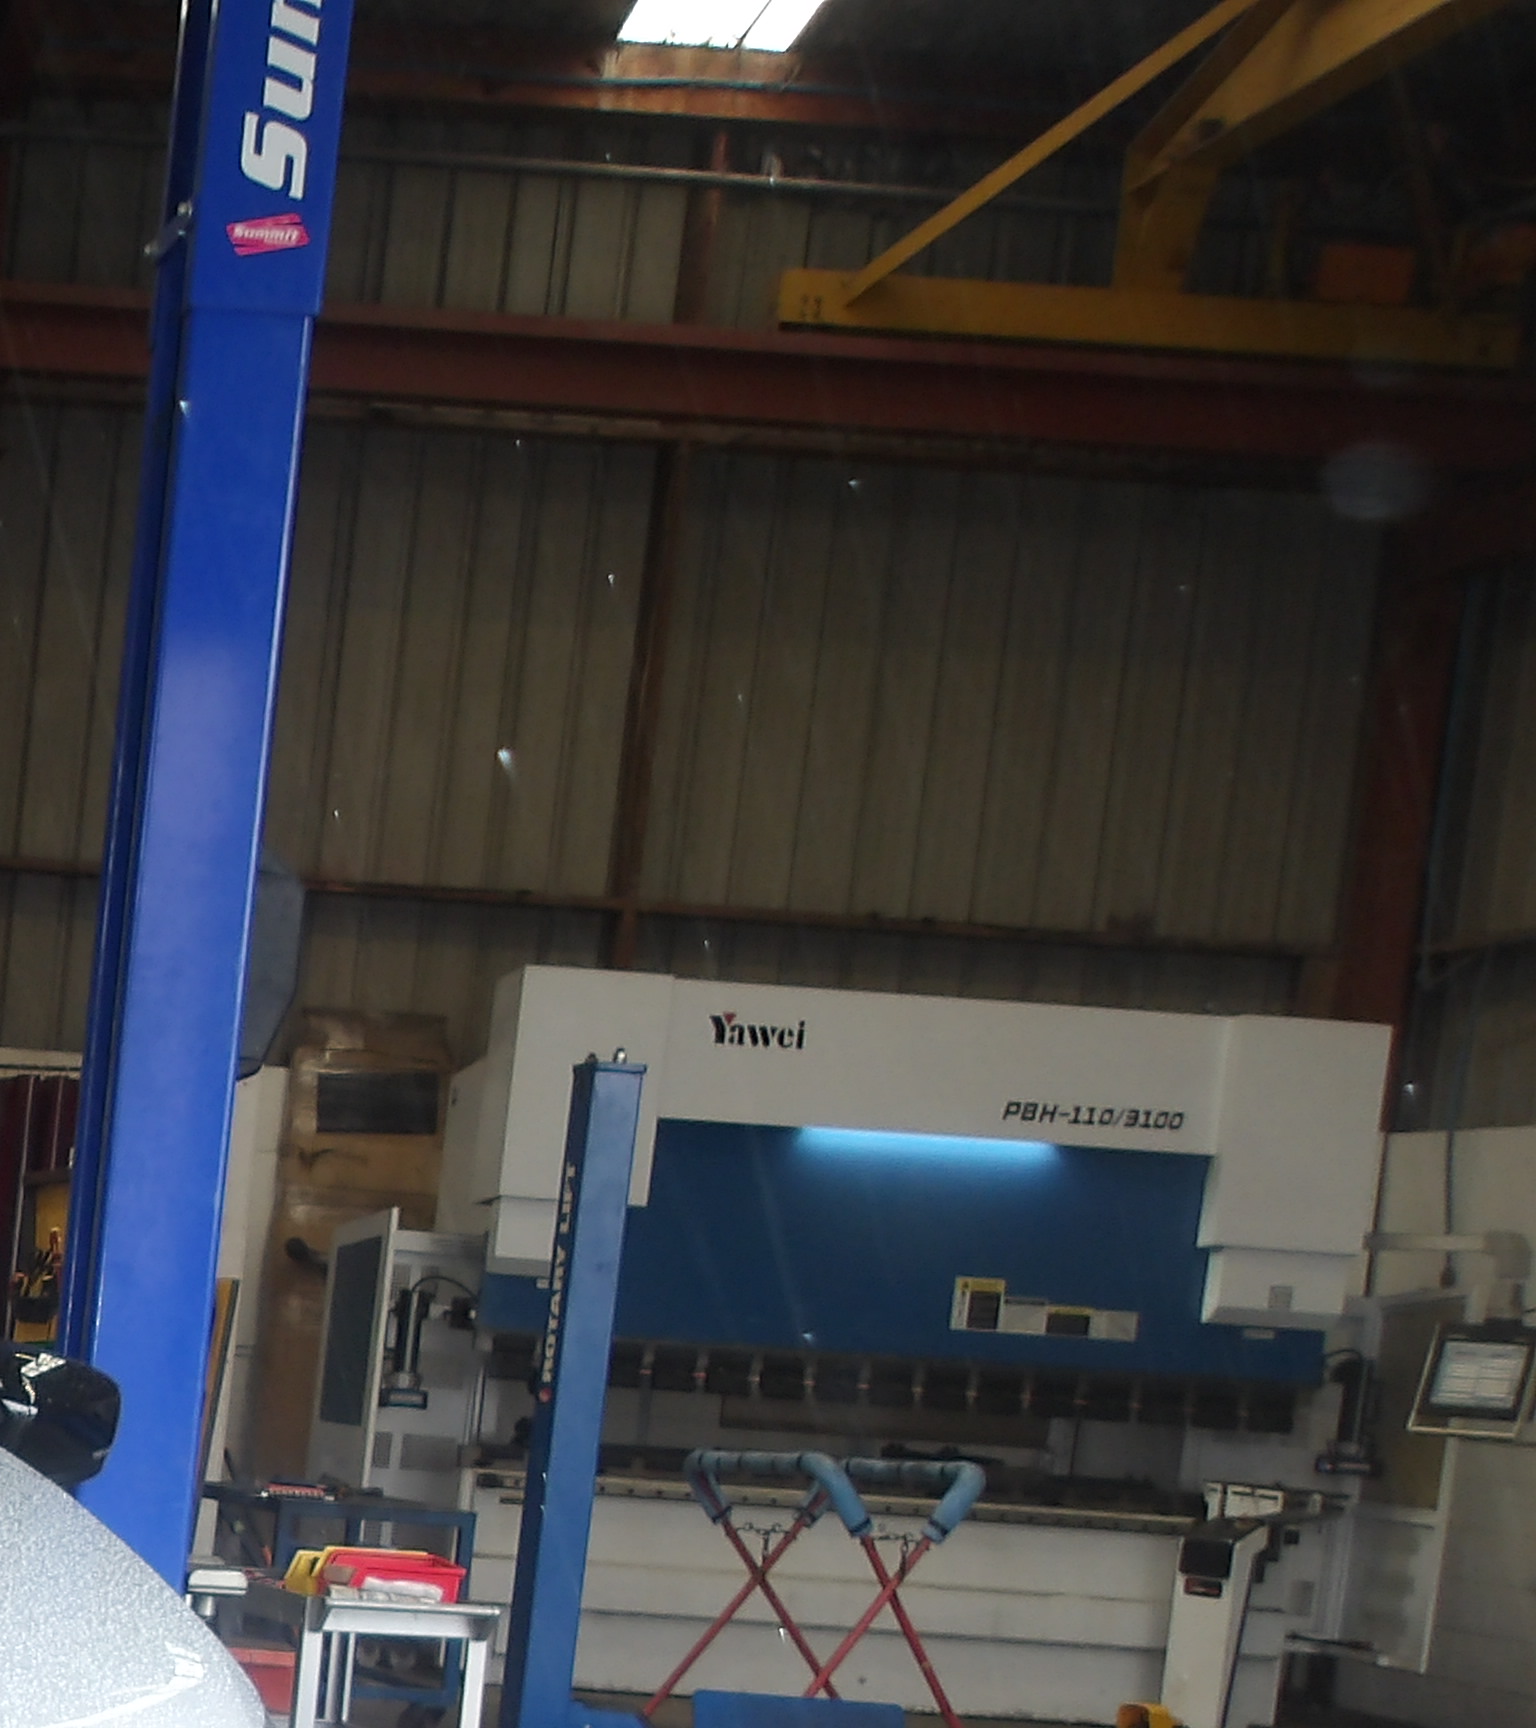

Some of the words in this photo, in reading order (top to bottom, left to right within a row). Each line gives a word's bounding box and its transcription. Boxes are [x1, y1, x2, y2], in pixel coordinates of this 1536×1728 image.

[233, 222, 300, 241] Summit
[708, 1011, 806, 1050] Yawei
[1001, 1100, 1185, 1131] PBH-110/3100
